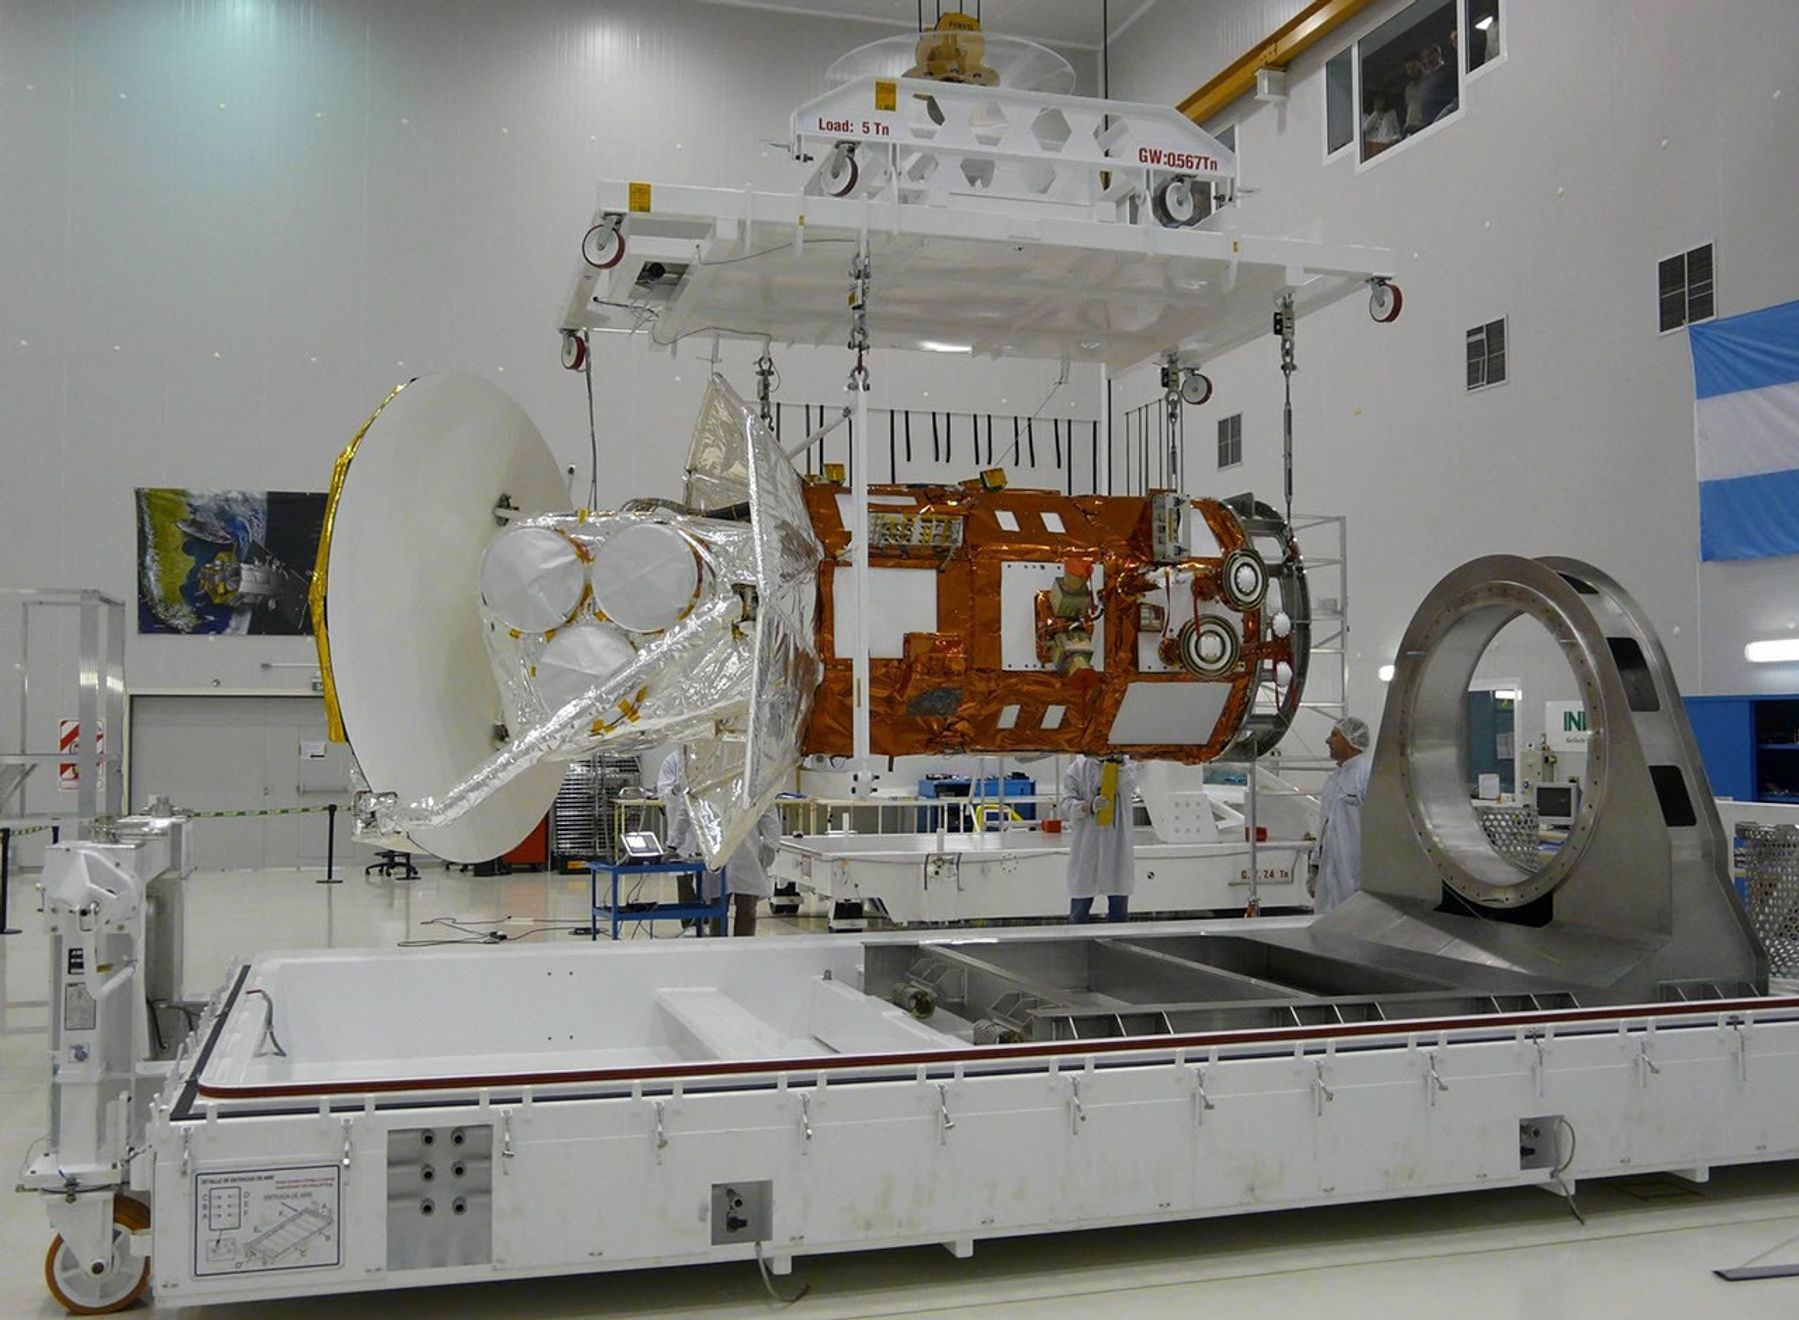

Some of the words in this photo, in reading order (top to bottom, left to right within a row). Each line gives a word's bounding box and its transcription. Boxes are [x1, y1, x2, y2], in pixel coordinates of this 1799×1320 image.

[818, 117, 854, 133] Load:
[862, 121, 870, 134] 5
[874, 122, 890, 136] Tn
